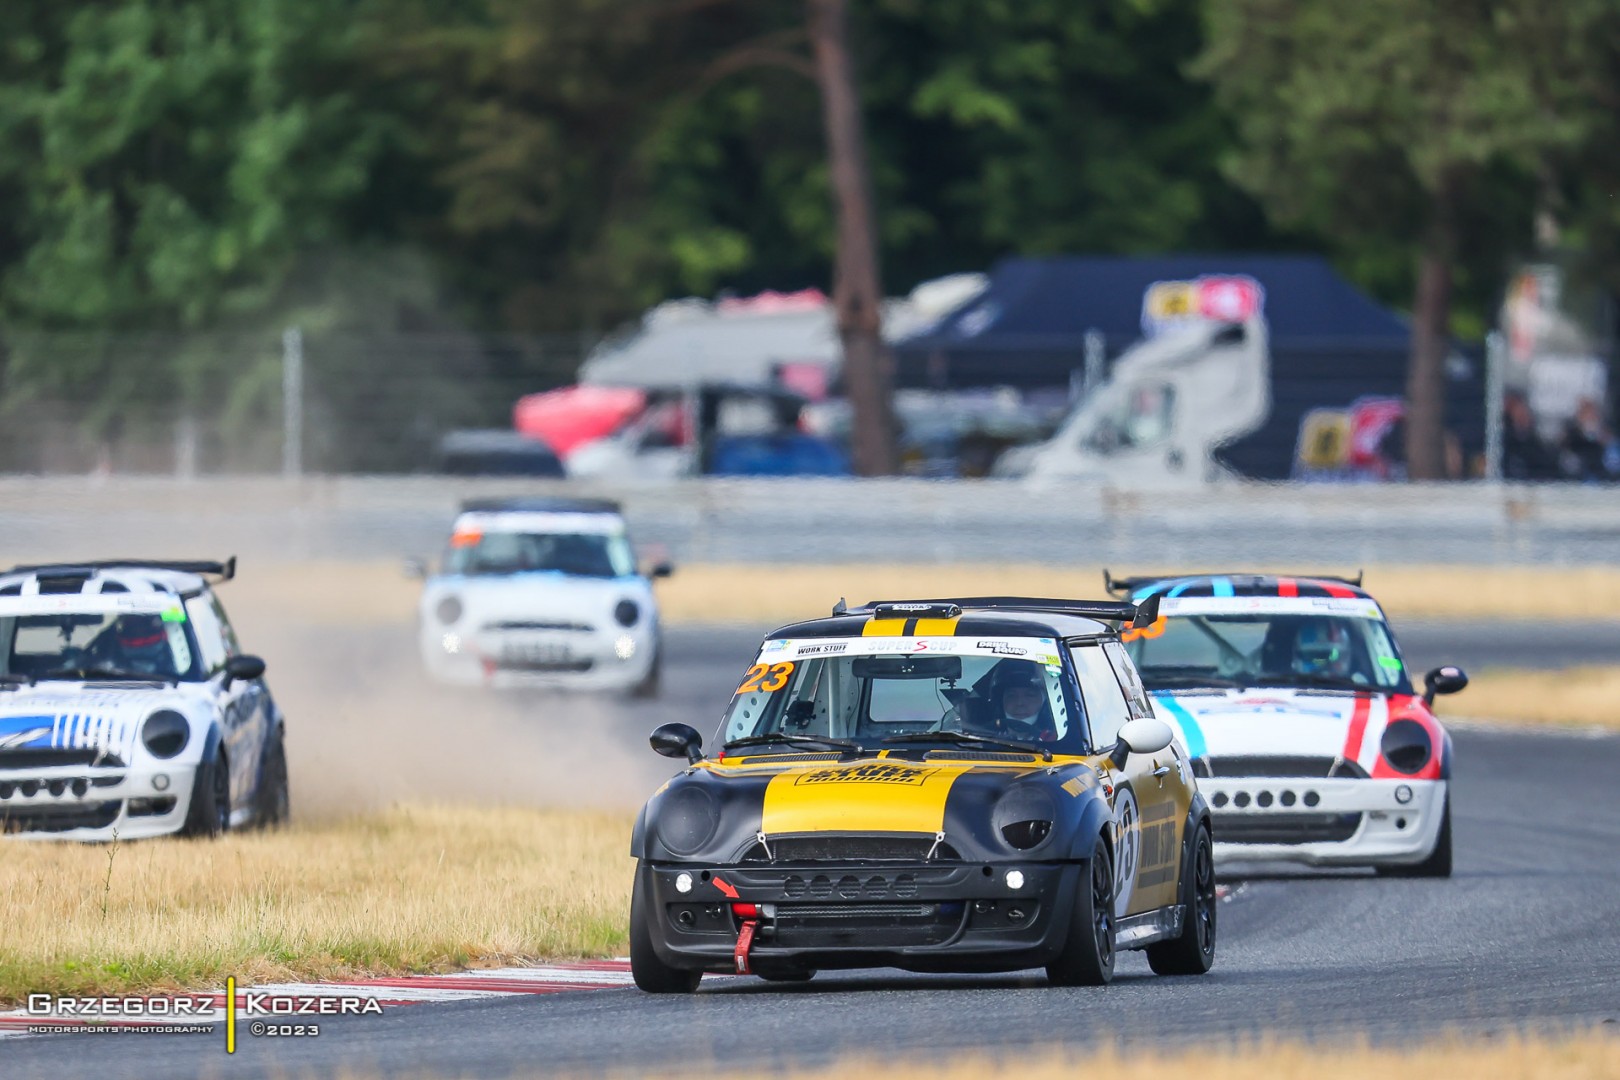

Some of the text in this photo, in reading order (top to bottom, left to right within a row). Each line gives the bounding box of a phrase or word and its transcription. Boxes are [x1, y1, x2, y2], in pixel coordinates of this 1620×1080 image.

[797, 645, 821, 655] WORK
[823, 644, 848, 653] STUFF
[976, 640, 1009, 649] DRIVE
[991, 646, 1028, 656] SQUAD
[735, 661, 795, 695] 23
